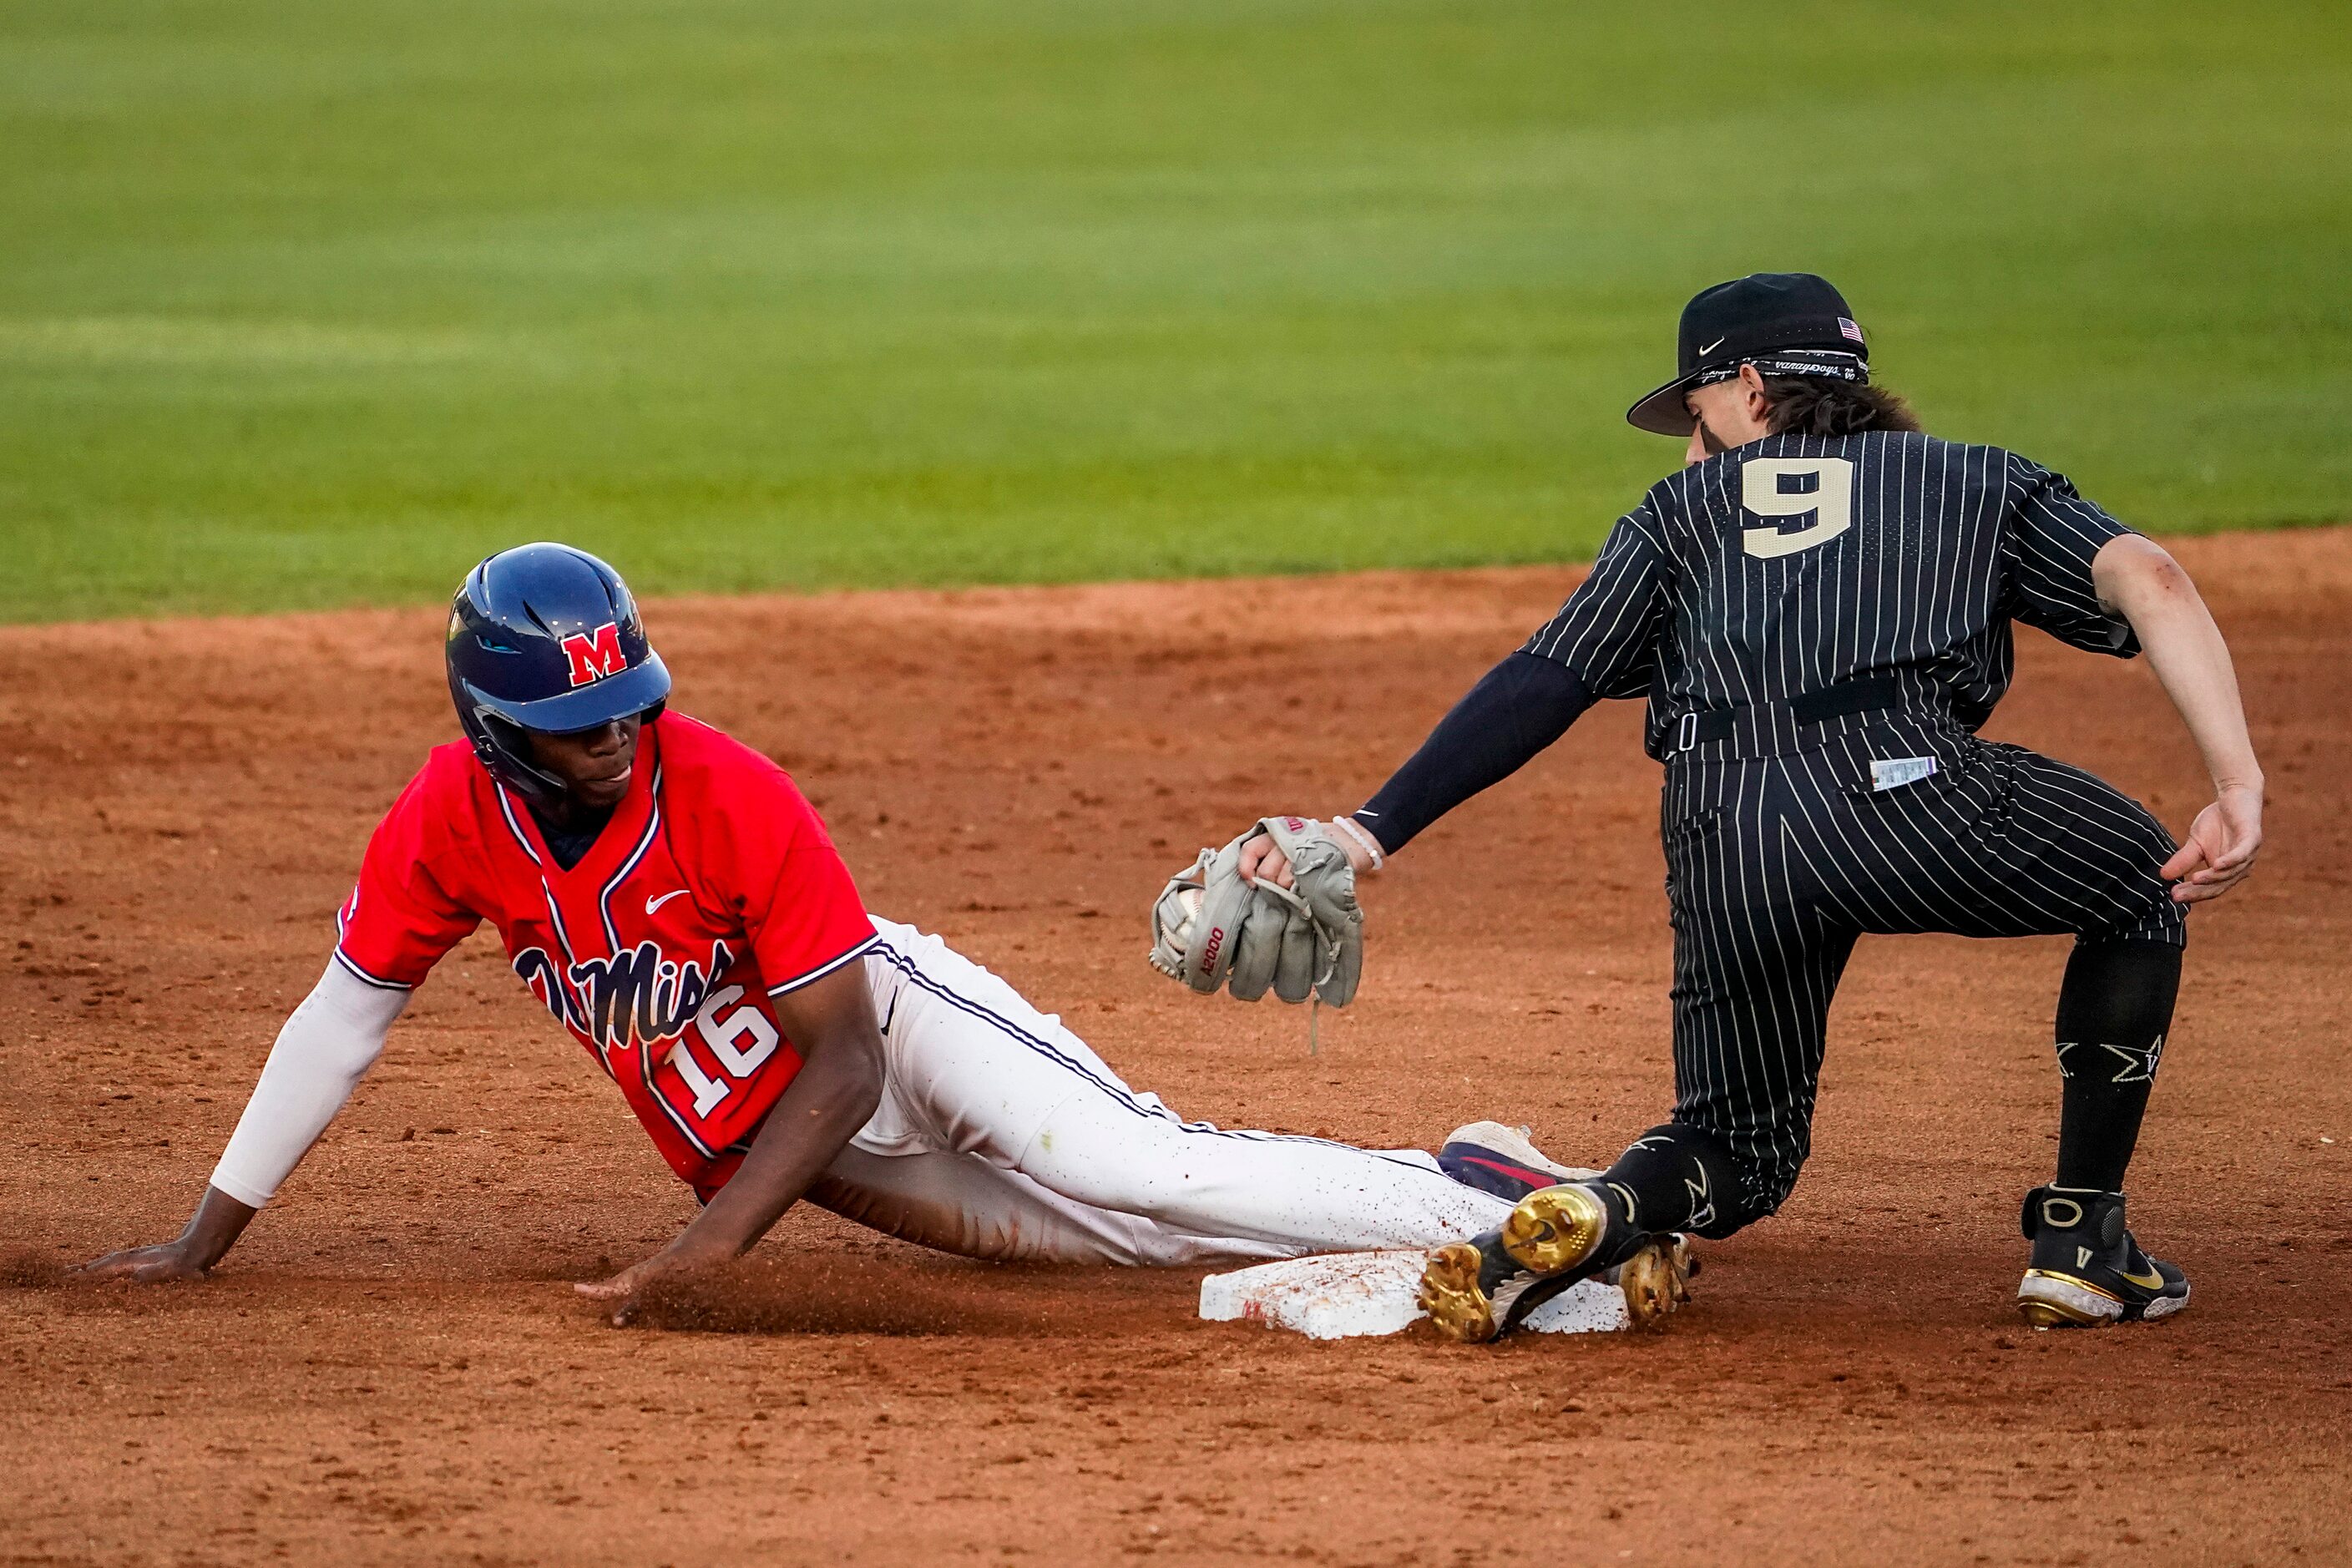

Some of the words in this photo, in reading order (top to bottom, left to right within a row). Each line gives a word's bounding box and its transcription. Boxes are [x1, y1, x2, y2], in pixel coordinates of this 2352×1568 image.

[1741, 457, 1855, 560] 9
[560, 622, 628, 688] M
[1200, 927, 1224, 977] A2000
[664, 984, 780, 1120] 16
